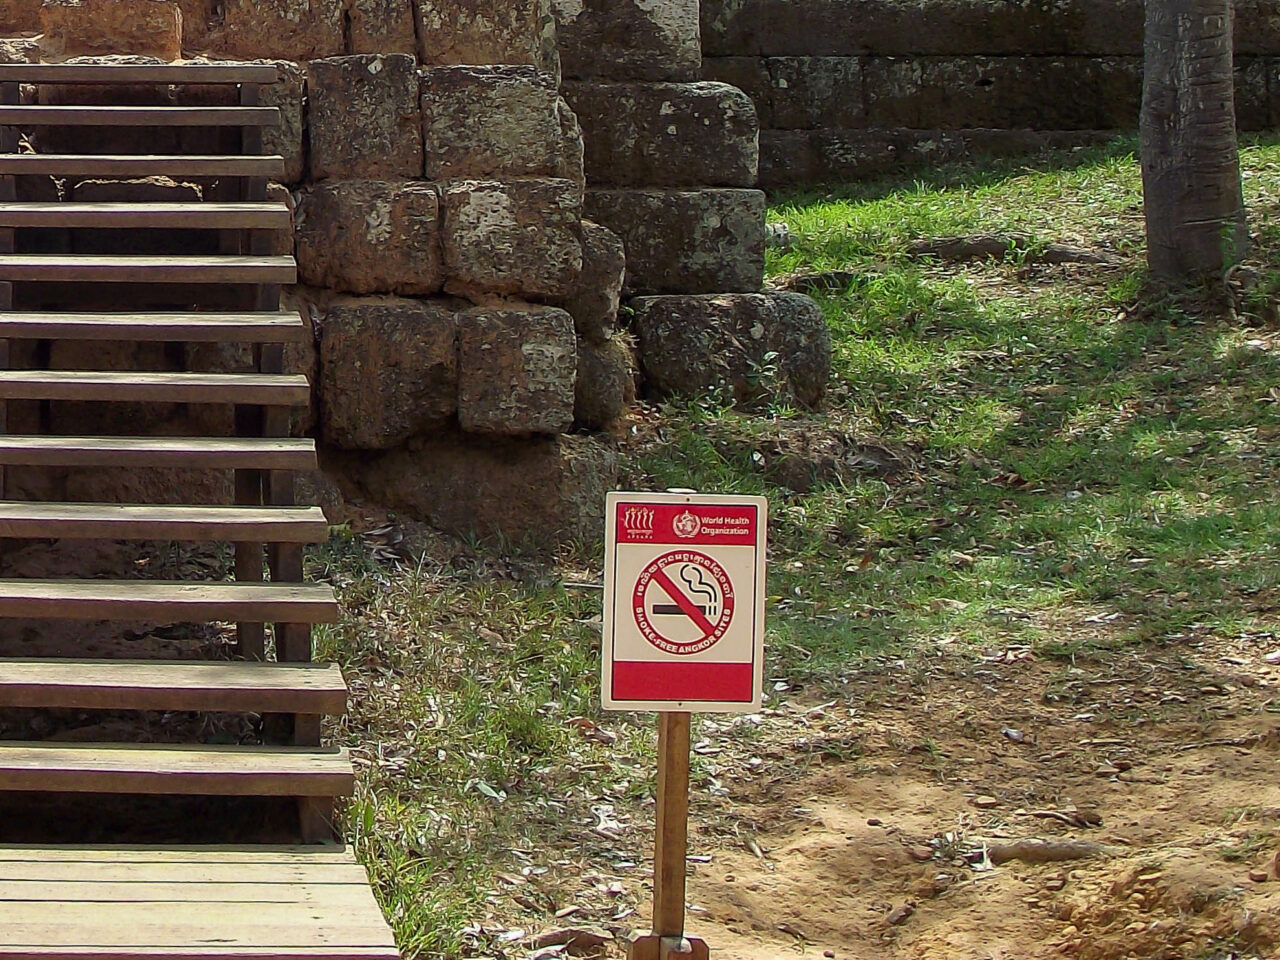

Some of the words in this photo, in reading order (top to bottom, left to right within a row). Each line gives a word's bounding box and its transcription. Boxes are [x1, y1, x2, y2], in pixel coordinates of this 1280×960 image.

[724, 517, 750, 525] Health
[701, 526, 749, 537] Organization
[636, 606, 679, 653] SMOKE-FREE
[679, 636, 716, 653] ANGKOR
[714, 608, 731, 637] SITES
